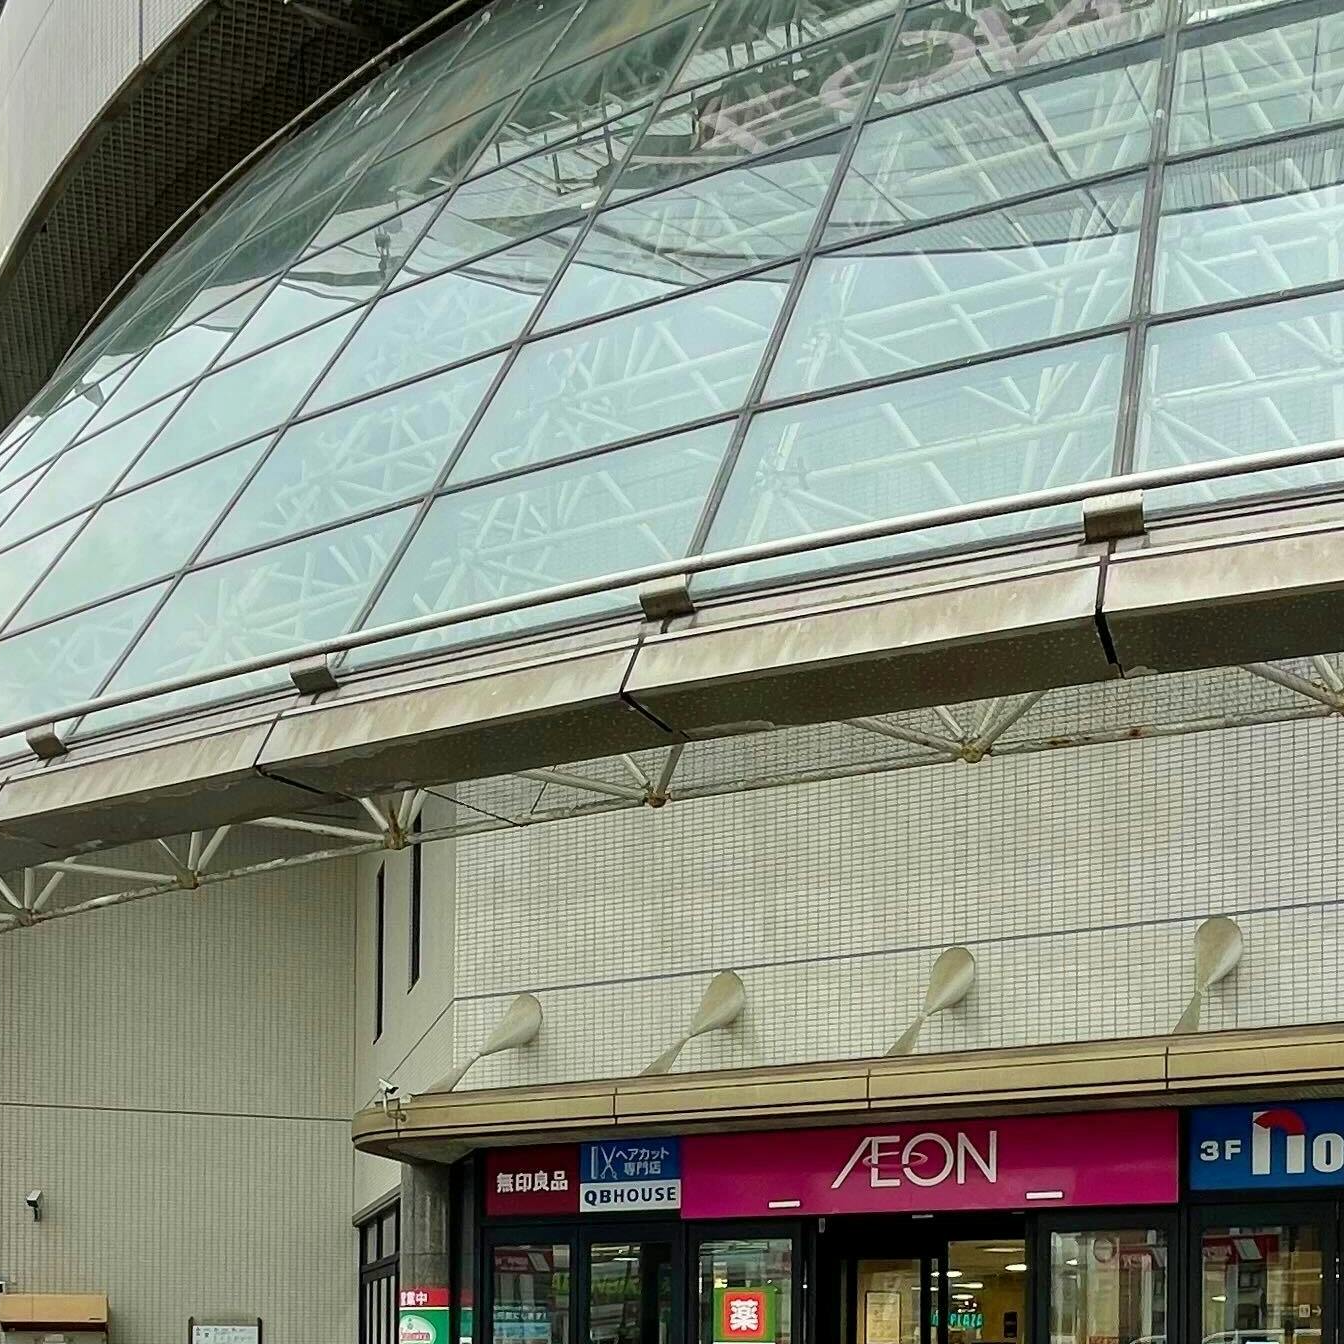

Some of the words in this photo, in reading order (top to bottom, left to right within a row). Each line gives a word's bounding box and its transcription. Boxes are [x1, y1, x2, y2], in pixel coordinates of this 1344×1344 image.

[616, 1147, 670, 1161] ヘアカット
[1199, 1139, 1242, 1161] 3F
[624, 1161, 662, 1177] 専門店
[496, 1170, 569, 1194] 無印良品
[729, 1298, 759, 1332] 薬
